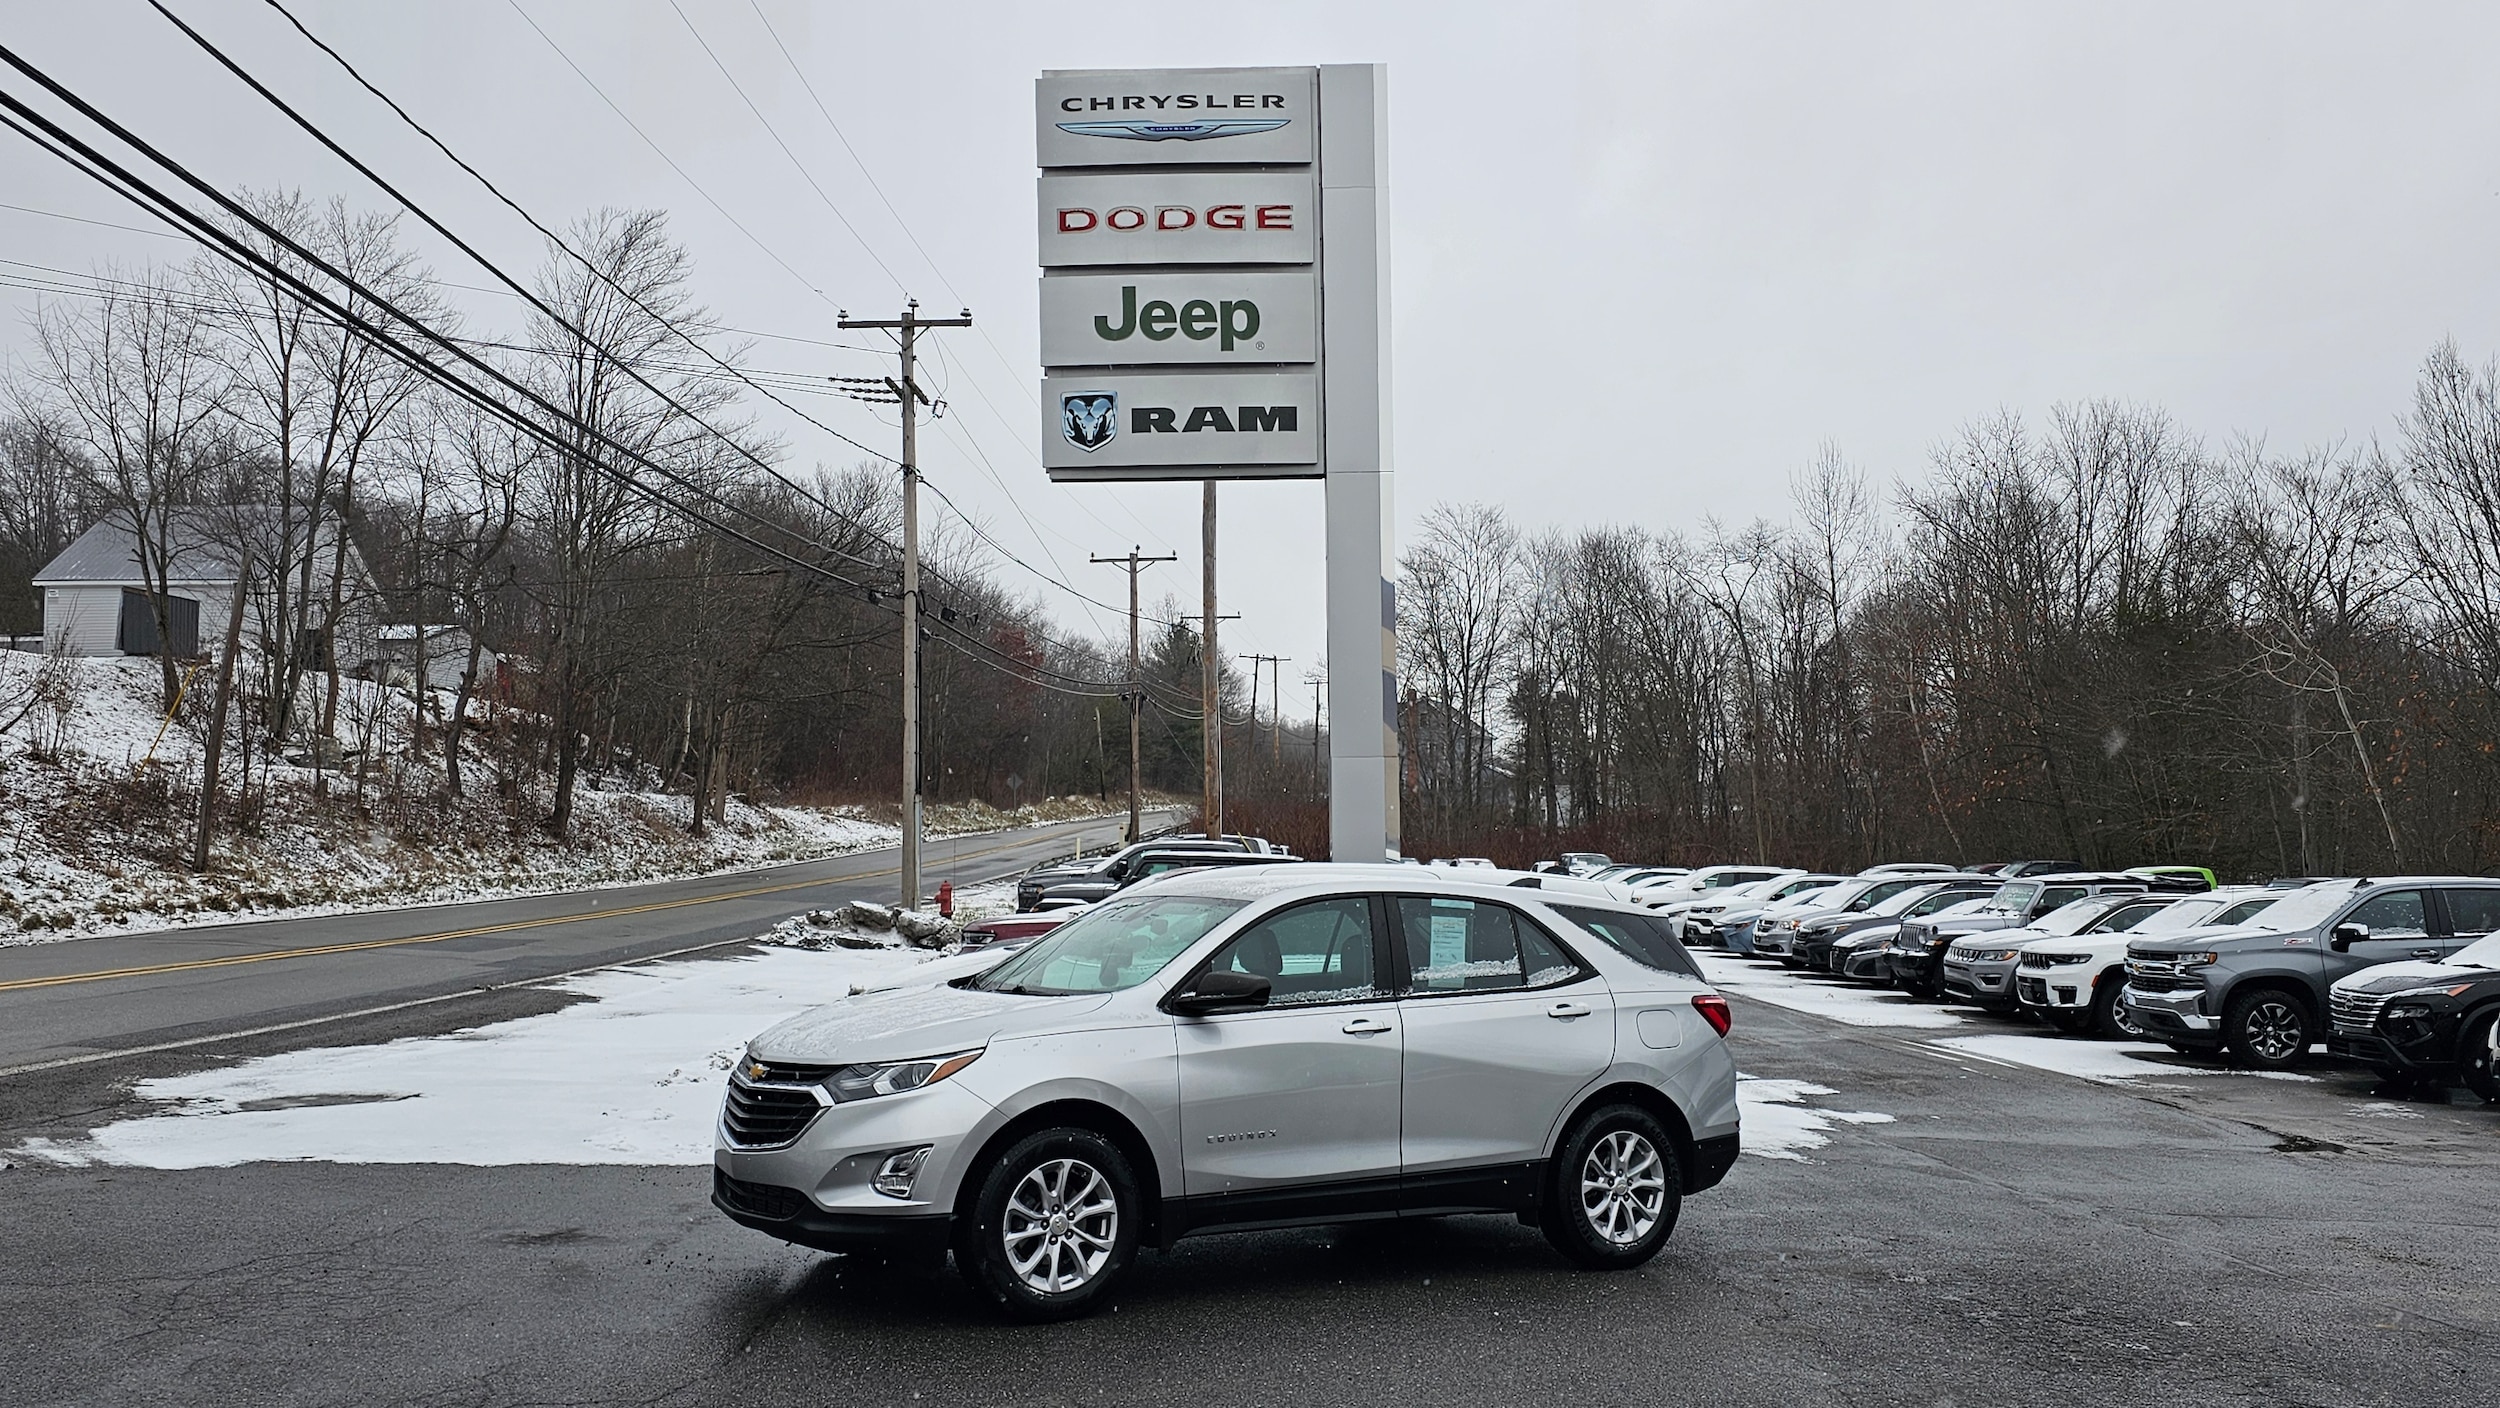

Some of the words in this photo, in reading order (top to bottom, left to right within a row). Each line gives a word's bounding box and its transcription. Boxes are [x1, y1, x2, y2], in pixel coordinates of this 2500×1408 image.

[1061, 94, 1285, 112] CHRYSLER
[1057, 205, 1294, 234] DODGE
[1094, 286, 1260, 351] Jeep
[1131, 406, 1297, 433] RAM
[1206, 1129, 1277, 1143] EQUINOX
